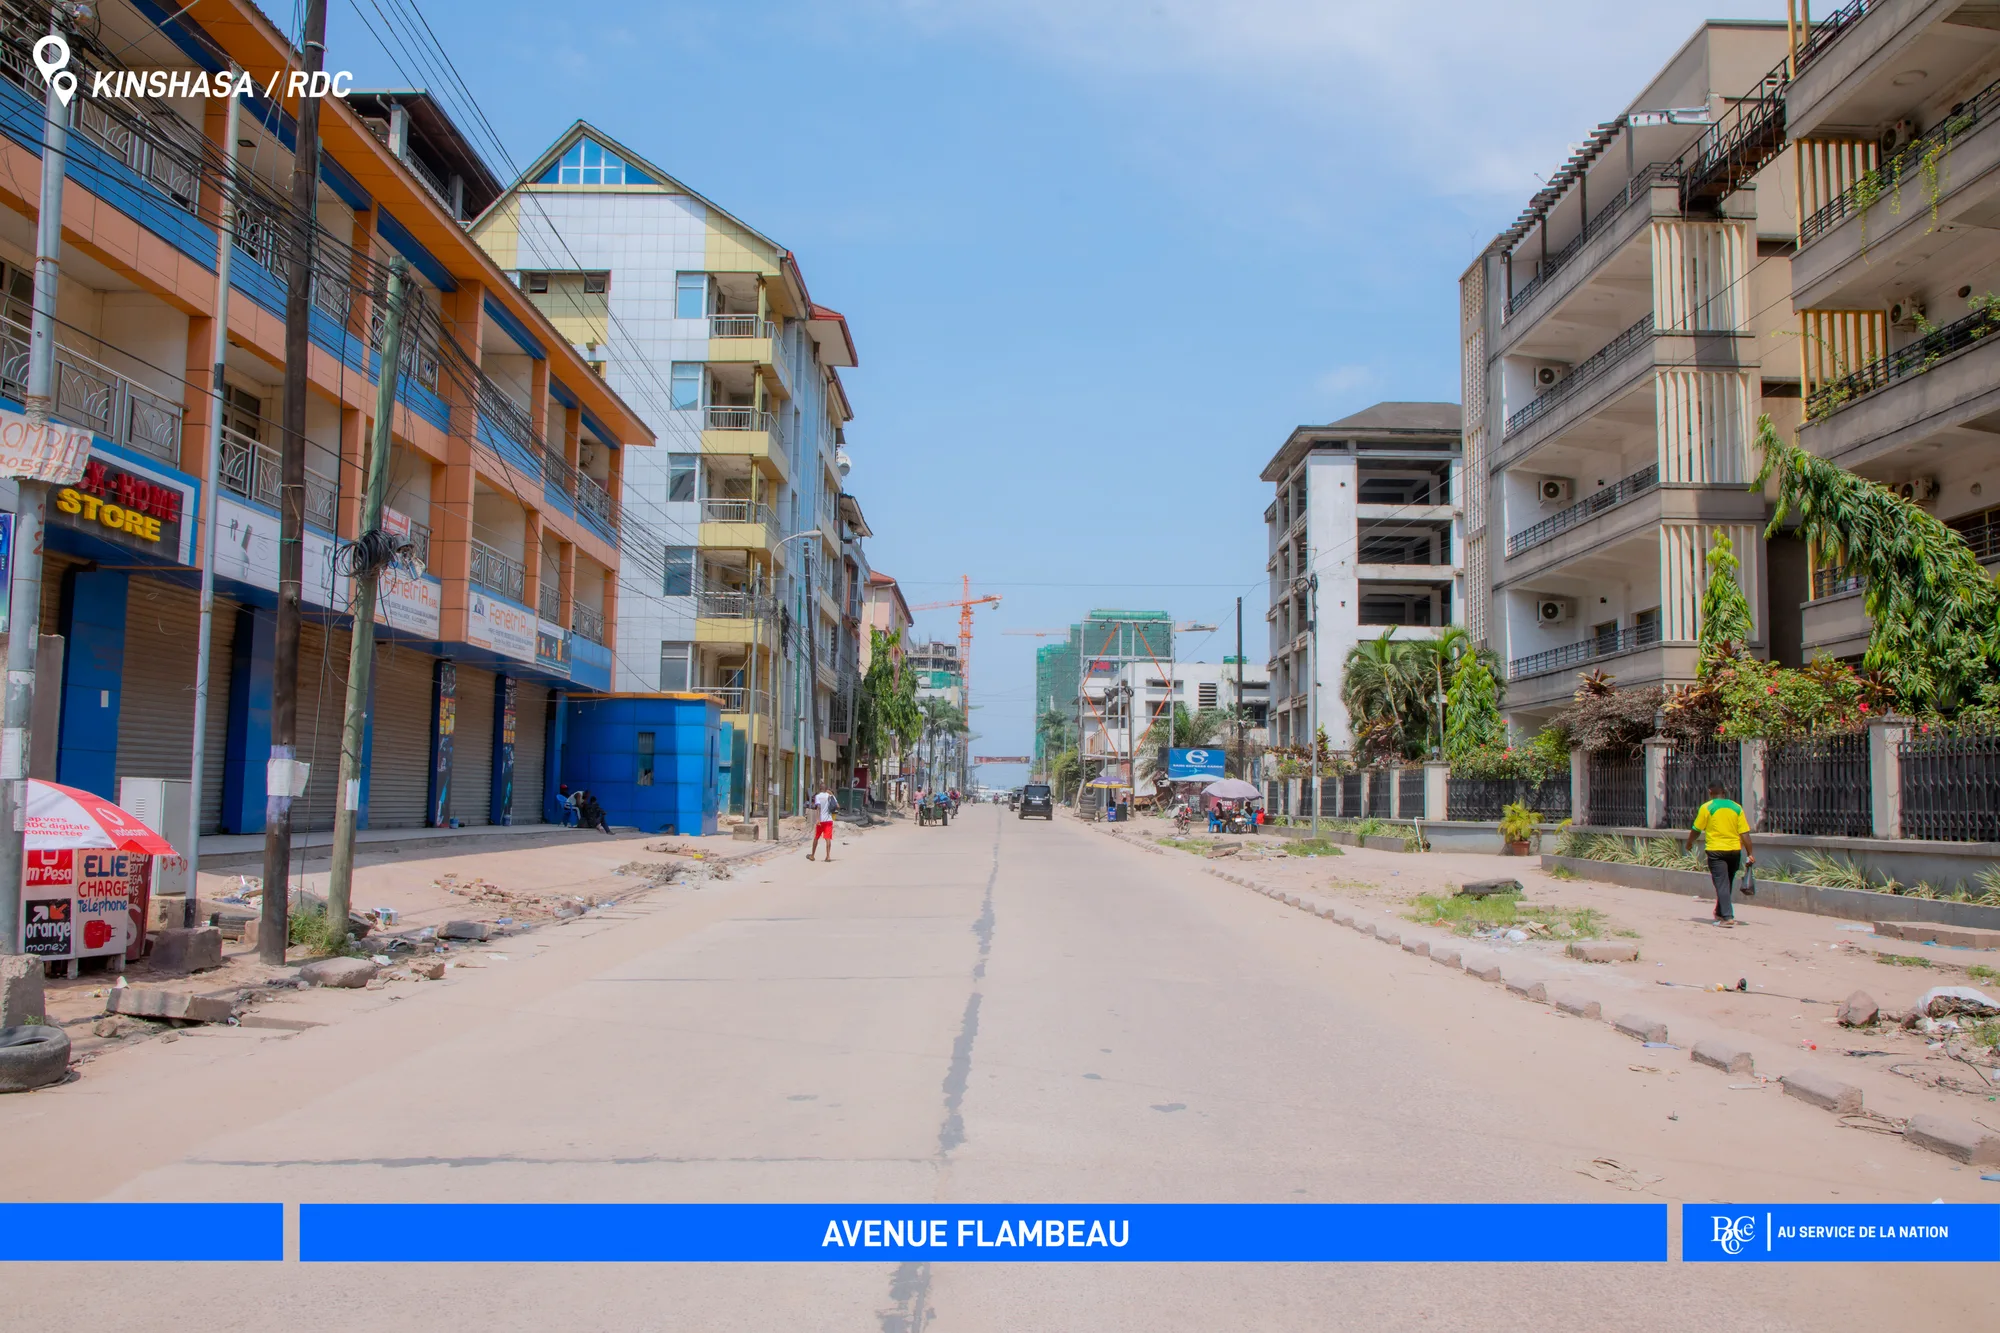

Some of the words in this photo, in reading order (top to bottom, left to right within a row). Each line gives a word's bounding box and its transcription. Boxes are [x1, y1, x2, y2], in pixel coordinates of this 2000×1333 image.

[56, 488, 161, 542] STORE
[49, 823, 91, 831] digitale
[84, 855, 129, 877] ELIE
[78, 880, 129, 898] CHARGE
[26, 921, 71, 942] orange
[26, 943, 67, 952] money
